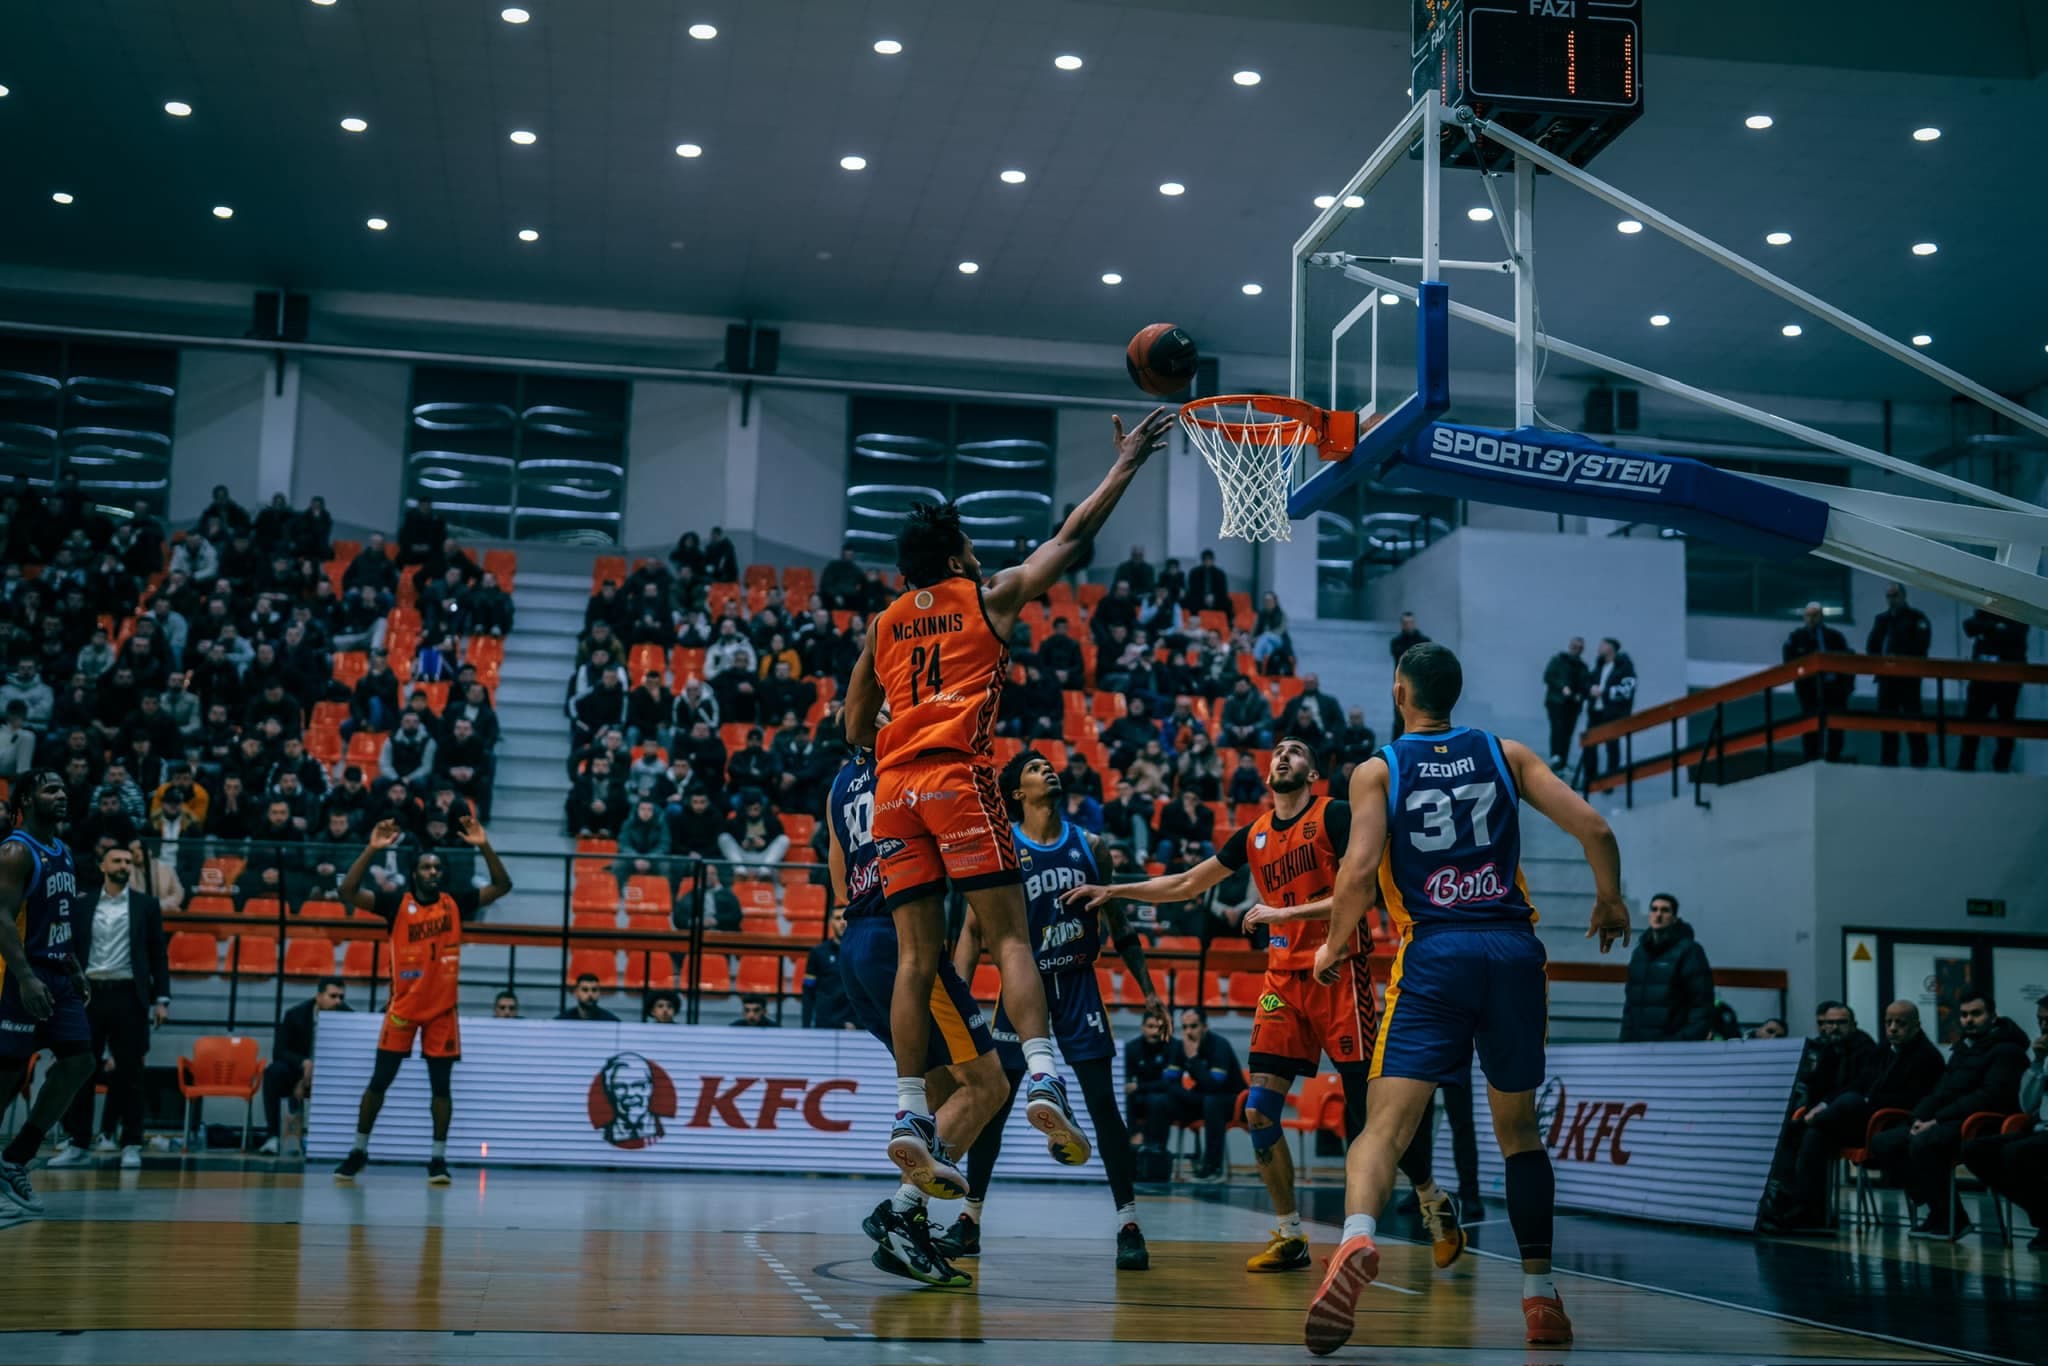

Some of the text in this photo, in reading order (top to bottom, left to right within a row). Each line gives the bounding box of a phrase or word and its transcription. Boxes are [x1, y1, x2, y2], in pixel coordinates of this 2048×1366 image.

[1529, 0, 1576, 18] FAZI
[893, 614, 963, 641] McKINNIS
[911, 643, 943, 707] 24
[1417, 757, 1477, 778] ZEDIRI
[1405, 782, 1497, 852] 37
[1260, 843, 1319, 894] ASHKIMI
[1426, 864, 1506, 906] Bora
[59, 899, 70, 916] 2
[1086, 1010, 1105, 1033] 4
[685, 1076, 859, 1132] KFC
[1556, 1102, 1648, 1165] KFC
